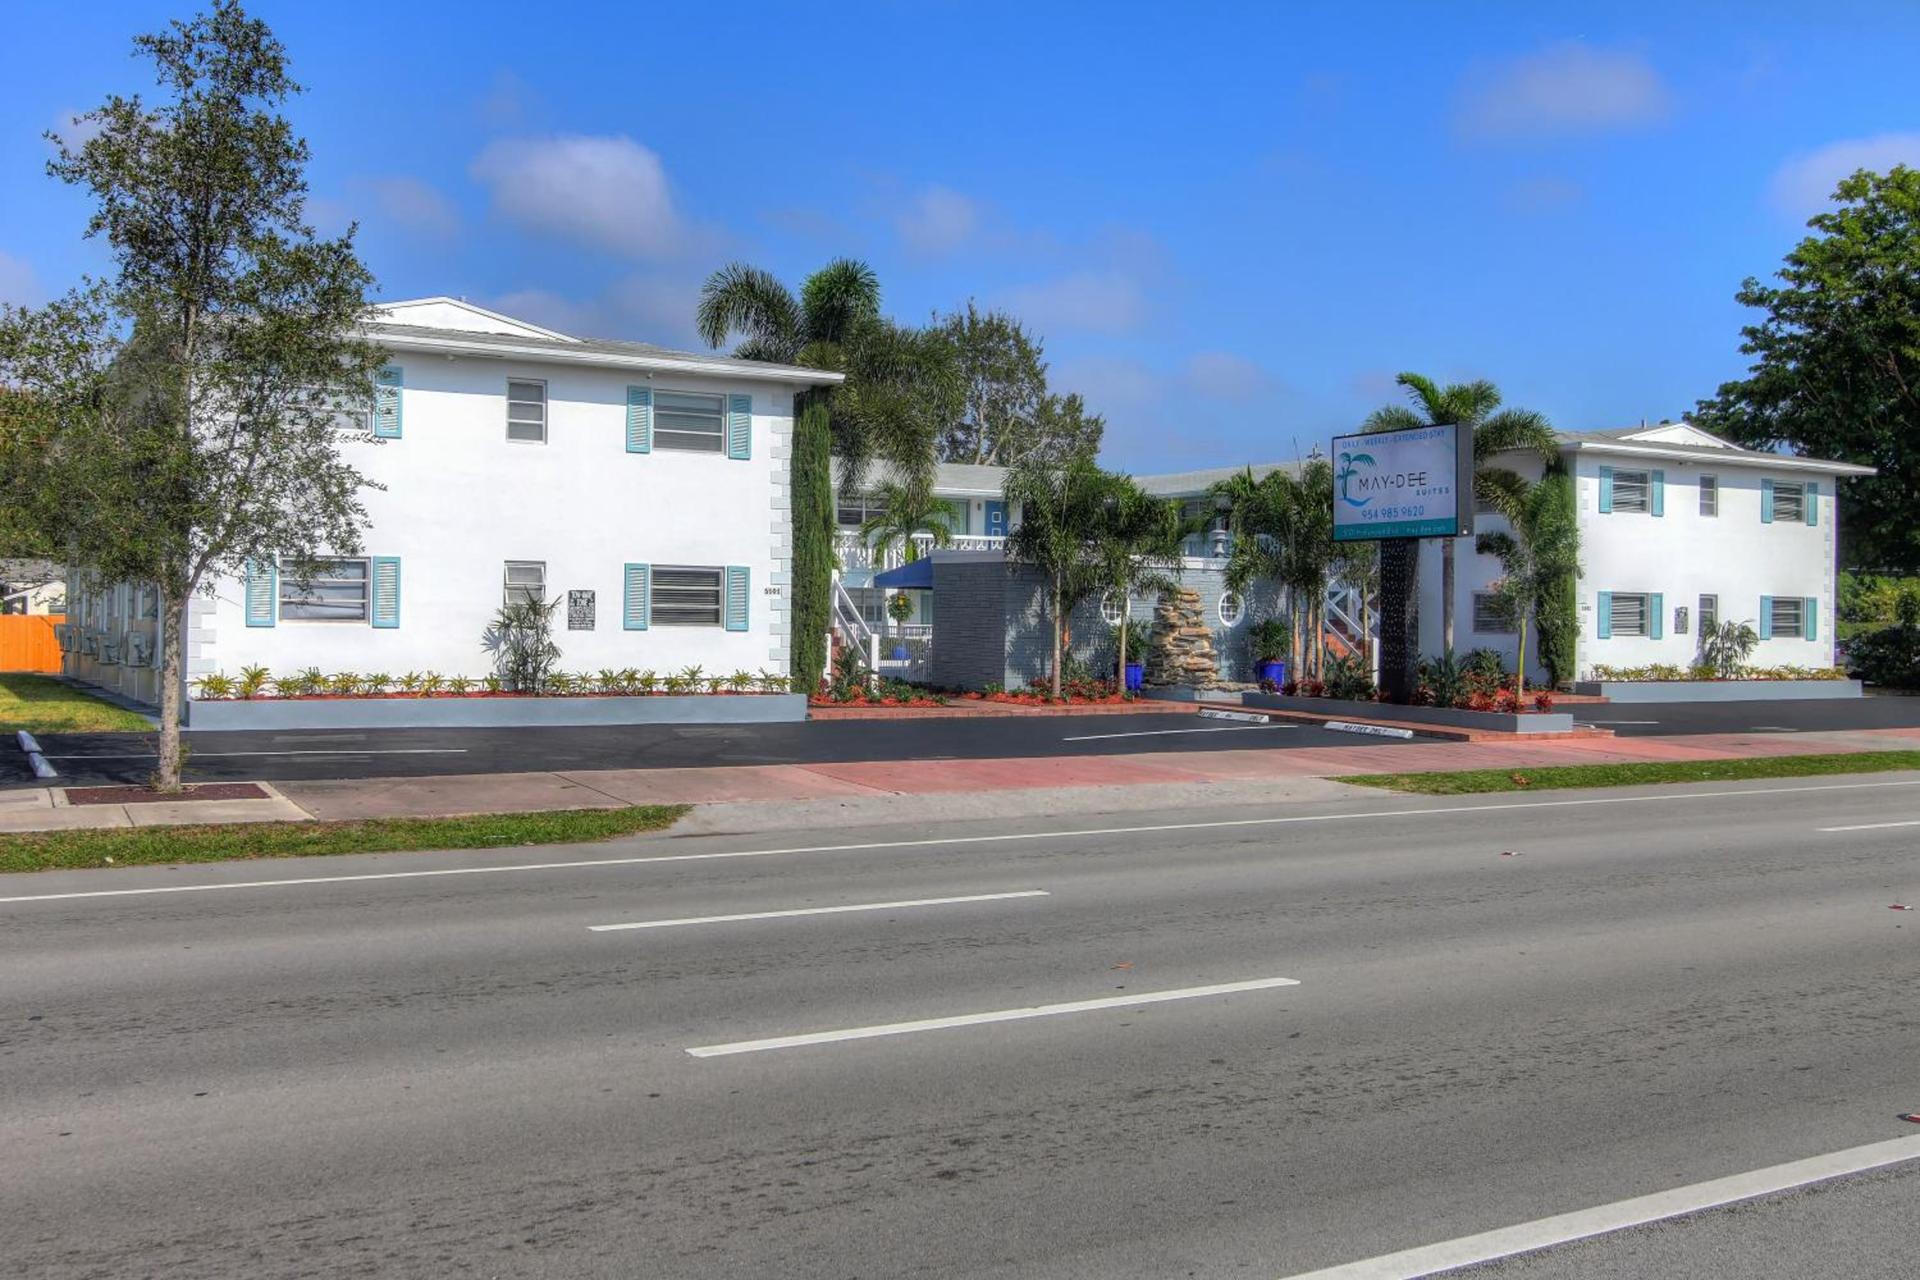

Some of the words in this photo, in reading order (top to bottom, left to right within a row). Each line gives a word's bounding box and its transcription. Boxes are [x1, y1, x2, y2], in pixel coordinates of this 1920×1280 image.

[1358, 471, 1427, 491] MAY-DEE
[1416, 486, 1449, 496] SUITES
[1361, 508, 1378, 520] 954
[1381, 507, 1399, 519] 985
[1401, 505, 1425, 517] 9620
